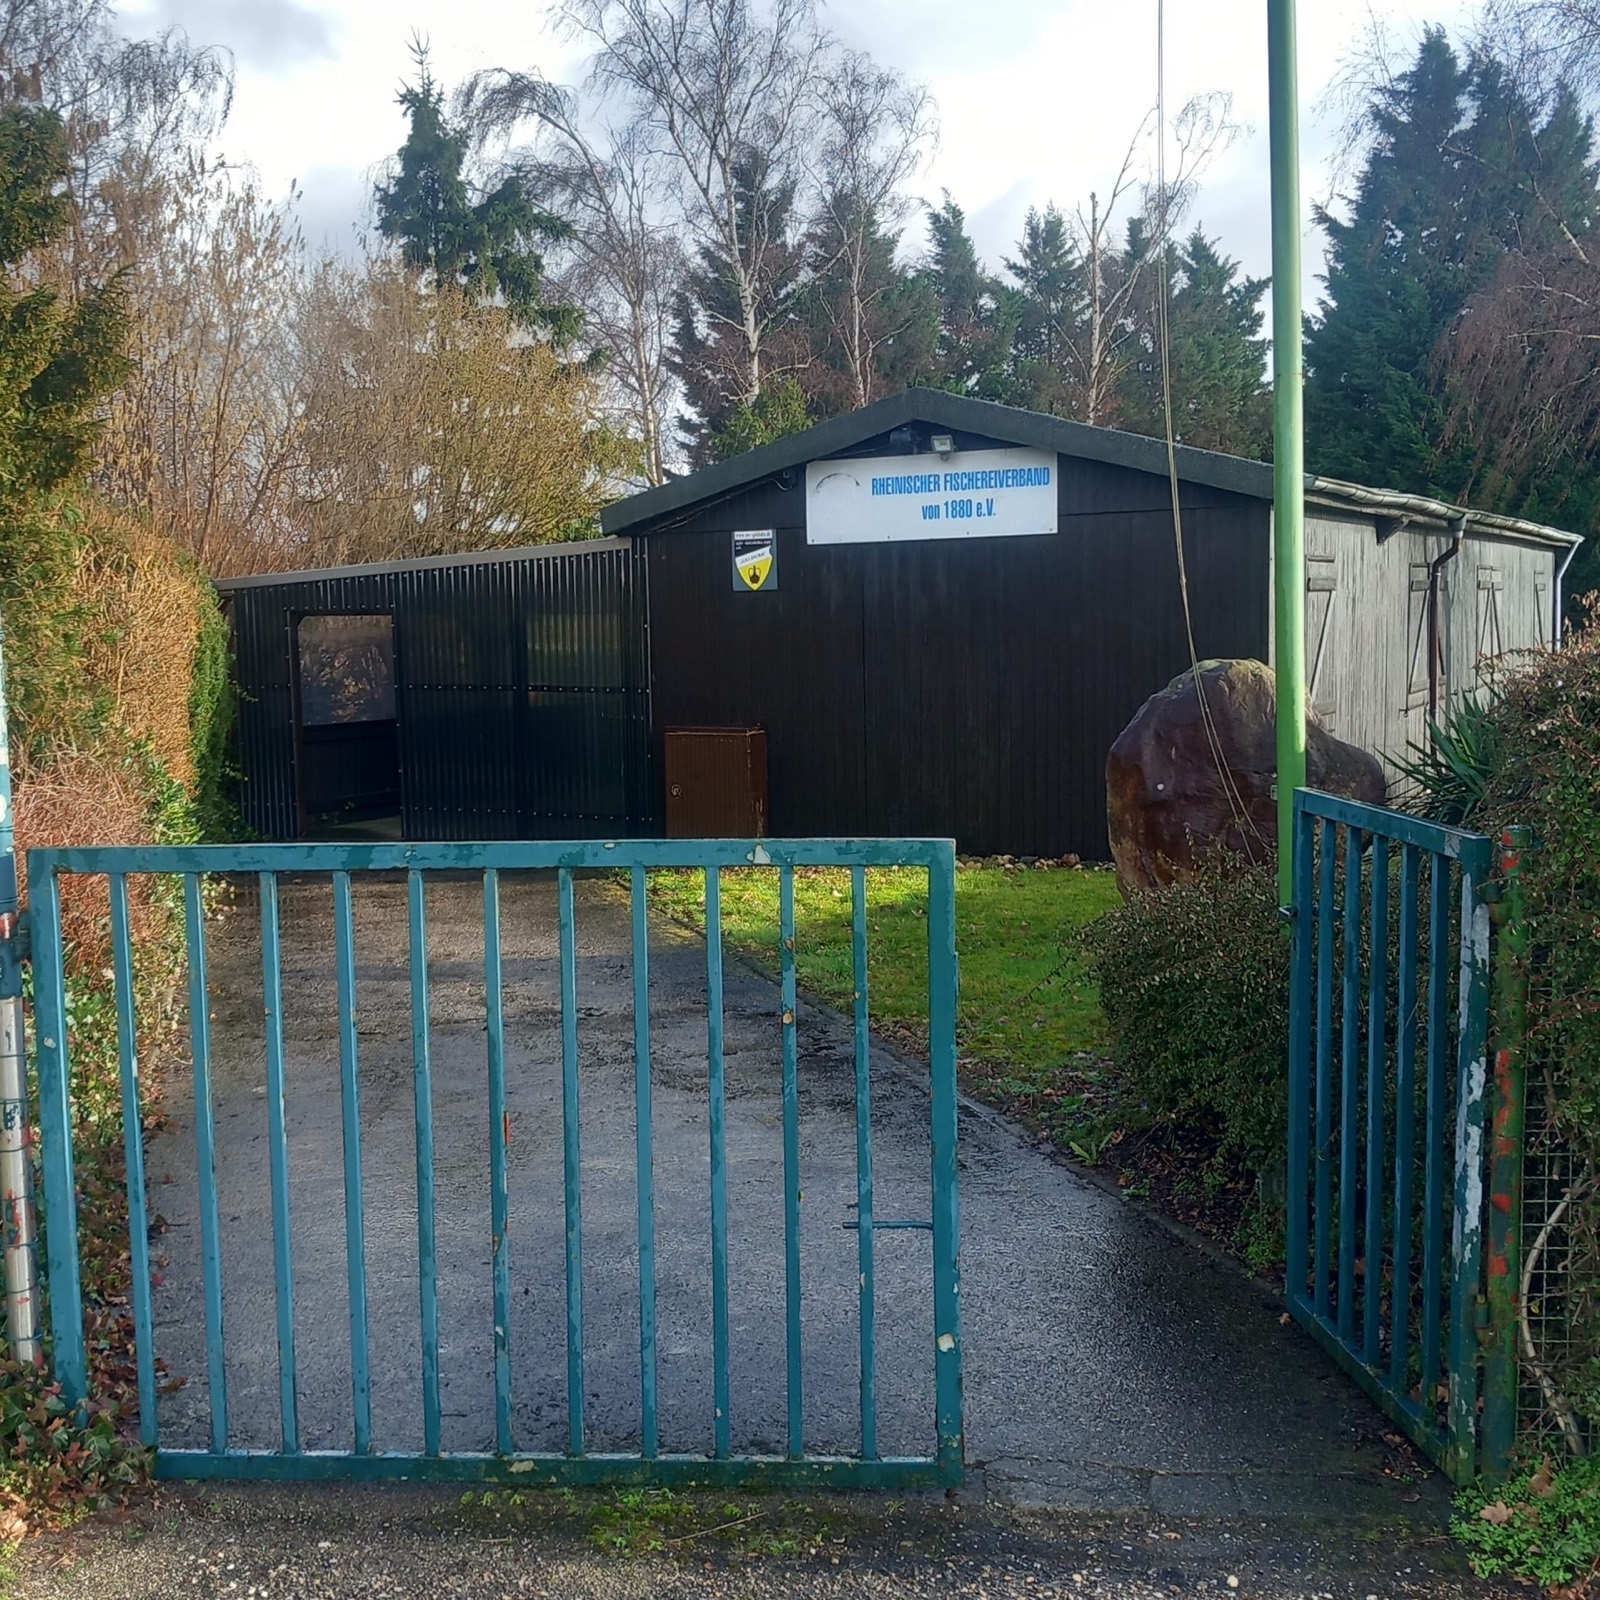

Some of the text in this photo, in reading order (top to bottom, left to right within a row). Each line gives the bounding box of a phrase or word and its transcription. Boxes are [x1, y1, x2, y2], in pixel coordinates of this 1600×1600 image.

[871, 467, 1050, 496] RHEINISCHER FISCHEREIVERBAND
[921, 498, 996, 520] von 1880 e.V.
